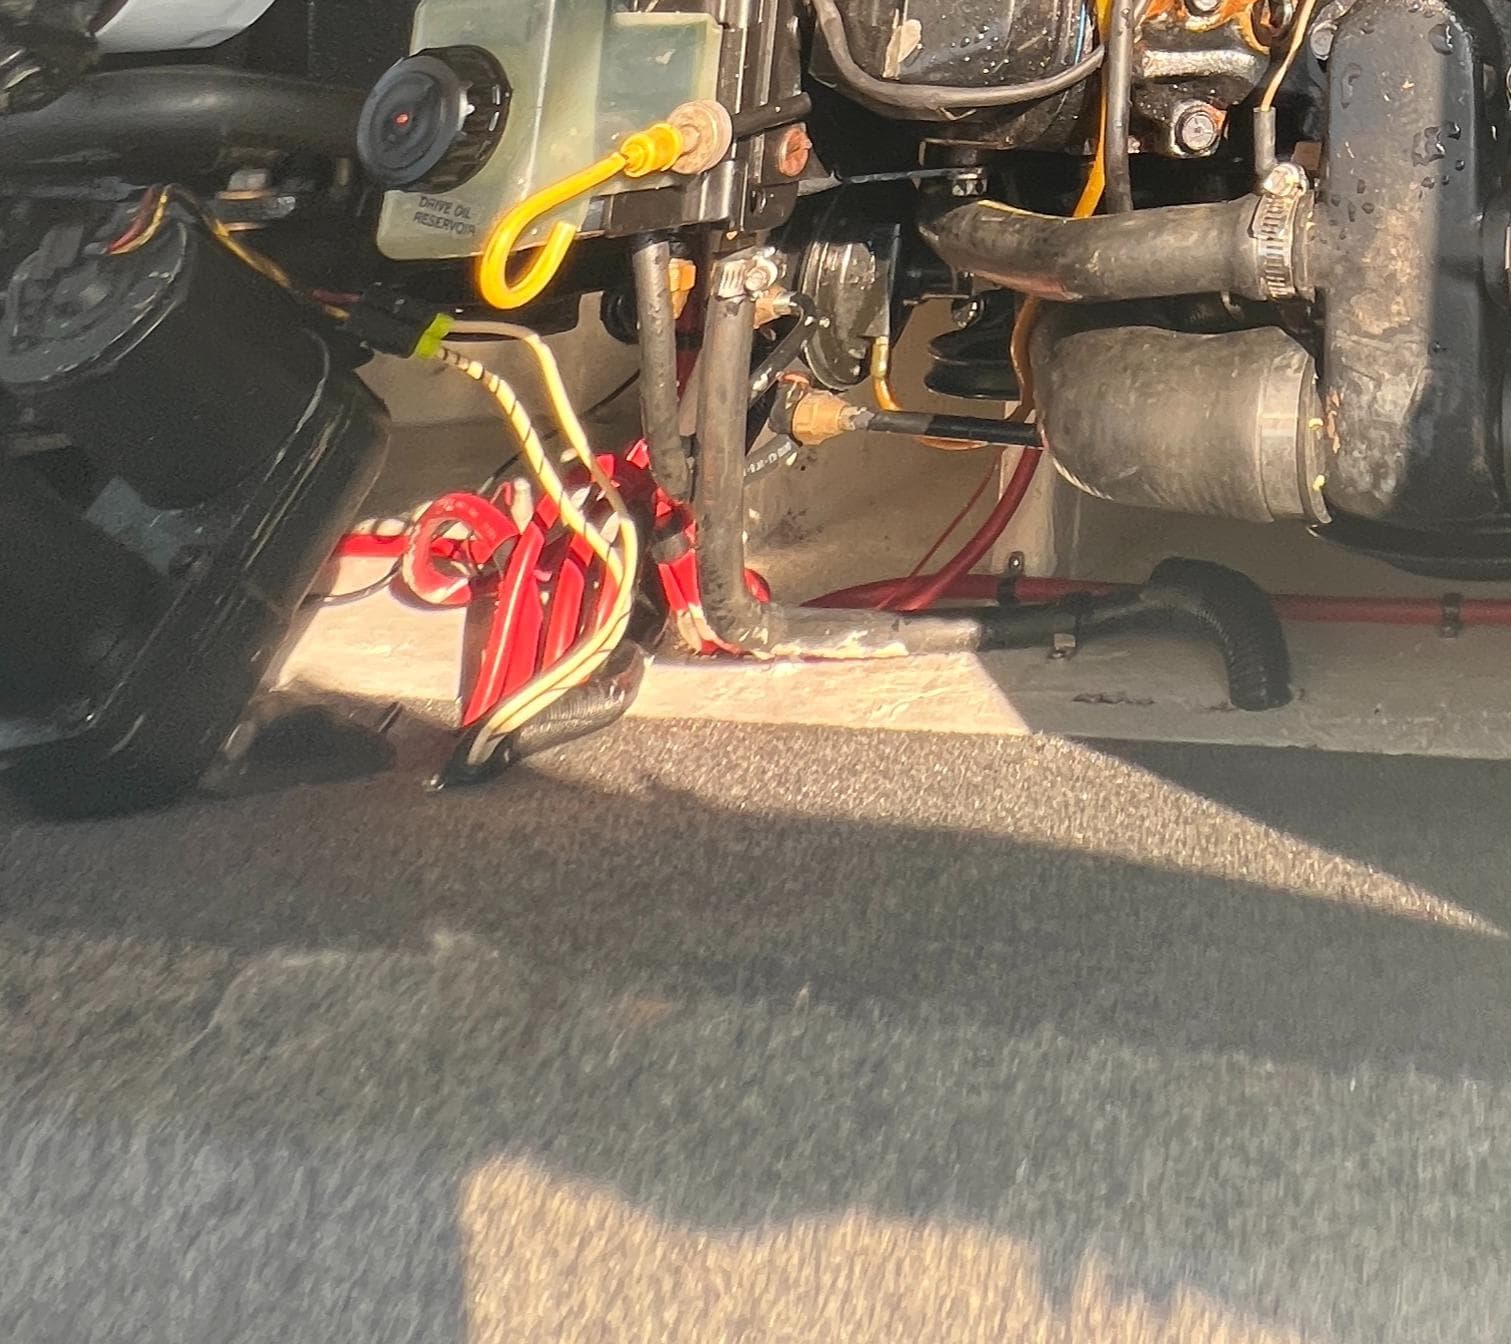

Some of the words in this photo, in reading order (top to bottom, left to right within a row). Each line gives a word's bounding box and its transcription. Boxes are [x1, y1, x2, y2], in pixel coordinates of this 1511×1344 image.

[418, 196, 452, 214] DRIVE
[454, 204, 472, 219] OIL
[414, 211, 475, 234] RESERVOIR
